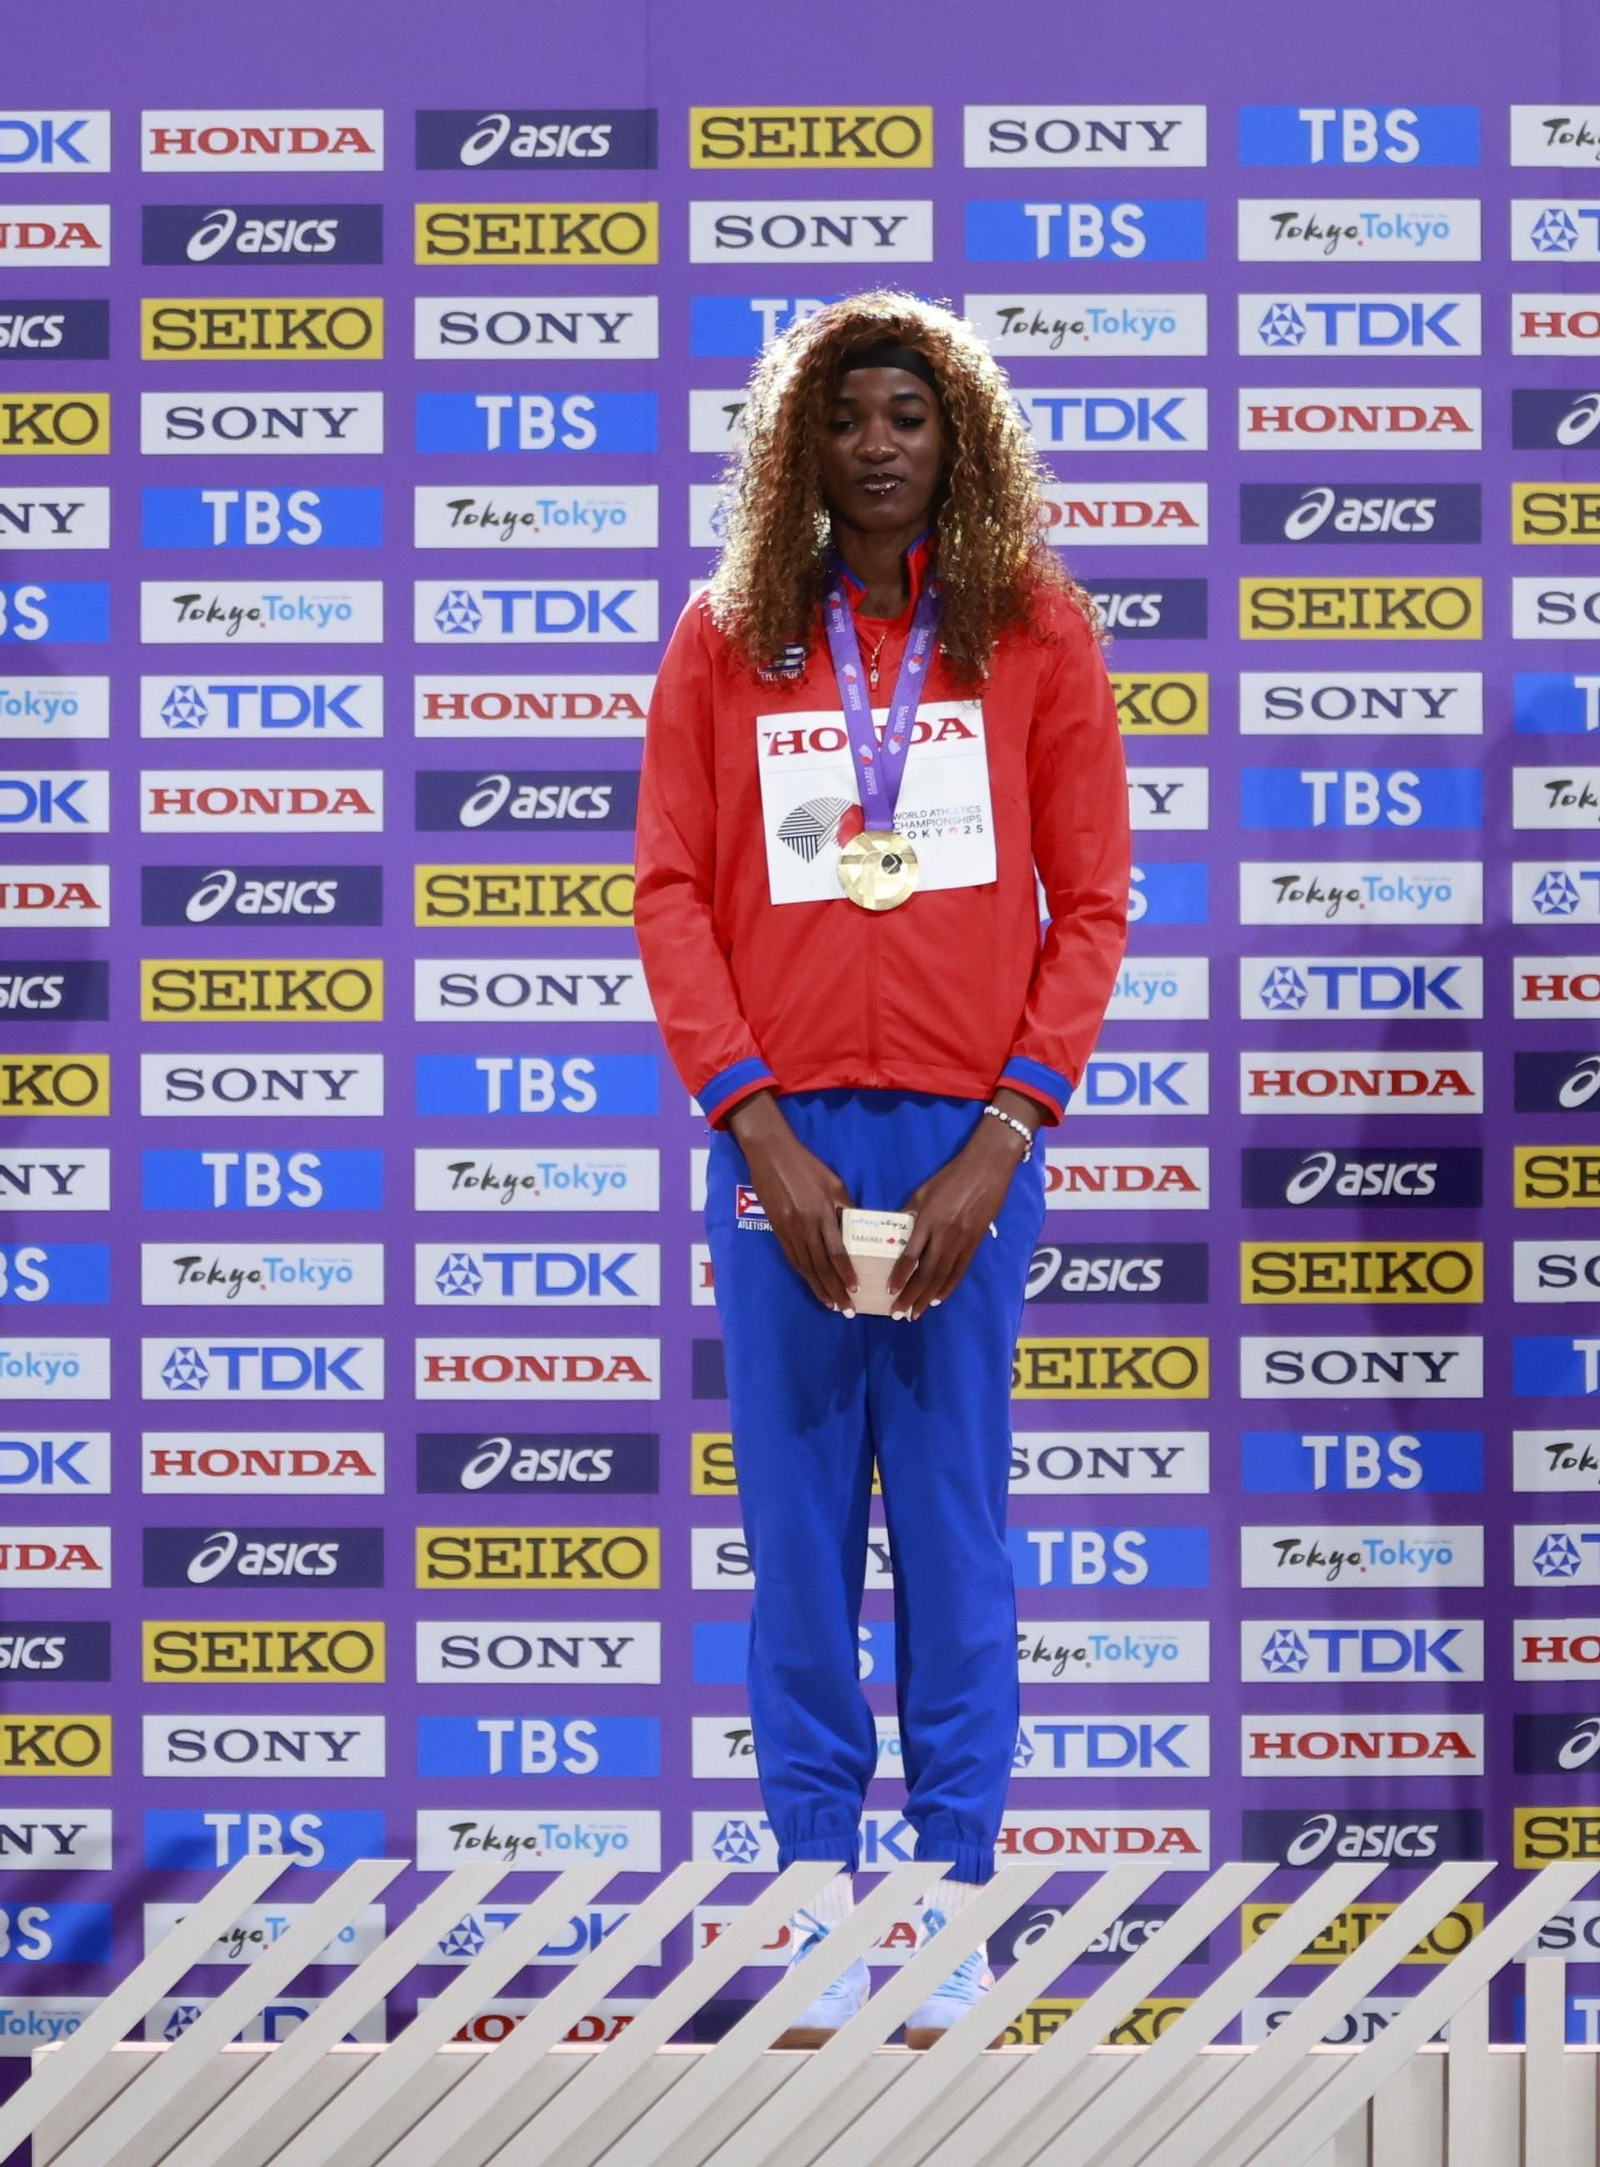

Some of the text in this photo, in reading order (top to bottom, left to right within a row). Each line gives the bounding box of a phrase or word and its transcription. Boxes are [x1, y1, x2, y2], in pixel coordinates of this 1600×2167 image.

[0, 117, 85, 160] DK
[149, 126, 374, 153] HONDA
[701, 116, 921, 159] SEIKO
[989, 120, 1182, 154] SONY
[1300, 110, 1420, 163] TBS
[1543, 118, 1600, 148] Tok
[427, 212, 646, 255] SEIKO
[715, 215, 908, 249] SONY
[1026, 205, 1145, 258] TBS
[1270, 212, 1450, 255] Tokyo Tokyo
[152, 308, 372, 350] SEIKO
[440, 310, 633, 344] SONY
[996, 308, 1175, 351] Tokyo Tokyo
[1307, 303, 1460, 346] TDK
[166, 406, 358, 440] SONY
[476, 395, 596, 449] TBS
[1032, 398, 1186, 442] TDK
[1248, 407, 1474, 433] HONDA
[0, 501, 84, 535] NY
[202, 491, 321, 545] TBS
[446, 498, 625, 542] Tokyo Tokyo
[1046, 502, 1199, 529] NDA
[172, 594, 351, 637] Tokyo Tokyo
[483, 589, 636, 632] TDK
[1251, 587, 1471, 630] SEIKO
[208, 685, 362, 728] TDK
[424, 693, 649, 720] HONDA
[1264, 687, 1458, 721] SONY
[763, 717, 978, 757] HODA
[0, 780, 87, 823] DK
[150, 788, 376, 816] HONDA
[894, 810, 928, 820] WORLD
[1302, 772, 1420, 825] TBS
[1545, 780, 1600, 810] Tok
[893, 815, 983, 831] CHAMPIONSHIPS
[427, 874, 635, 917] SEIKO
[1272, 875, 1451, 918] Tokyo Tokyo
[153, 969, 372, 1012] SEIKO
[441, 973, 634, 1007] SONY
[1308, 966, 1462, 1009] TDK
[166, 1068, 359, 1102] SONY
[477, 1058, 597, 1112] TBS
[1086, 1061, 1188, 1105] DK
[1249, 1069, 1475, 1096] HONDA
[0, 1163, 84, 1197] NY
[203, 1153, 322, 1207] TBS
[448, 1162, 627, 1204] Tokyo Tokyo
[1045, 1164, 1200, 1191] NDA
[173, 1257, 352, 1299] Tokyo Tokyo
[484, 1252, 638, 1295] TDK
[1251, 1249, 1472, 1292] SEIKO
[209, 1348, 364, 1391] TDK
[425, 1355, 651, 1382] HONDA
[1011, 1344, 1197, 1387] EIKO
[1265, 1349, 1459, 1384] SONY
[0, 1443, 89, 1486] DK
[150, 1450, 377, 1478] HONDA
[1303, 1435, 1421, 1488] TBS
[1545, 1442, 1600, 1472] Tok
[428, 1535, 648, 1578] SEIKO
[1028, 1530, 1147, 1583] TBS
[1273, 1538, 1452, 1580] Tokyo Tokyo
[153, 1631, 373, 1674] SEIKO
[442, 1635, 635, 1669] SONY
[1086, 1635, 1178, 1667] Tokyo
[1309, 1629, 1464, 1672] TDK
[167, 1730, 360, 1764] SONY
[478, 1721, 598, 1774] TBS
[1034, 1724, 1190, 1768] TDK
[1249, 1731, 1476, 1758] HONDA
[0, 1825, 86, 1859] NY
[204, 1816, 323, 1870] TBS
[449, 1825, 628, 1866] Tokyo Tokyo
